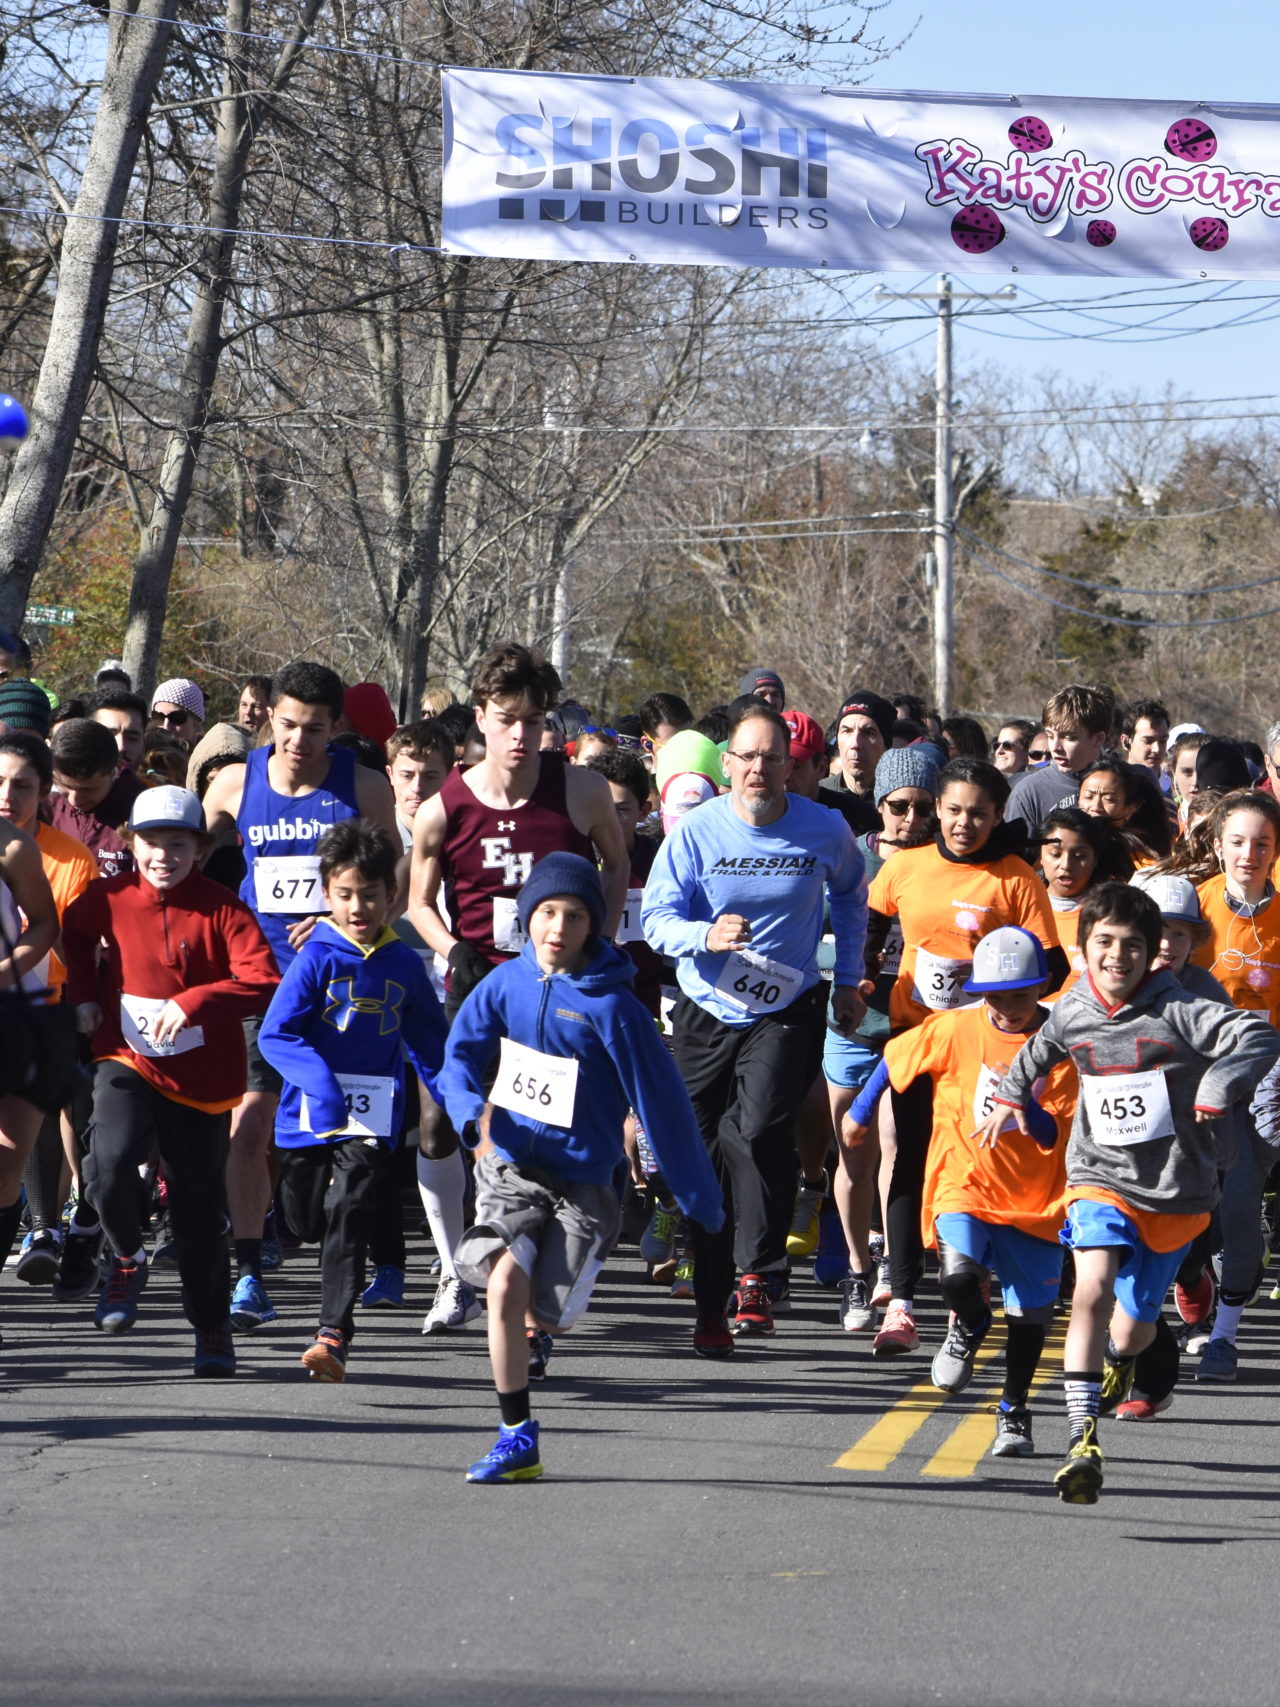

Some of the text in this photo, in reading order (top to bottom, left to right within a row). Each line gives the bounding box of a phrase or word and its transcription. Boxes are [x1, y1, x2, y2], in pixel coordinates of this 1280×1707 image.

[495, 112, 828, 199] SHOSHI
[923, 146, 1109, 217] Katy's
[618, 200, 830, 230] BUILDERS
[709, 868, 815, 877] TRACK & FIELD
[713, 856, 818, 870] MESSIAH
[272, 878, 317, 900] 677
[733, 973, 781, 1005] 640
[929, 992, 960, 1004] Chiara
[512, 1071, 553, 1107] 656
[1100, 1094, 1147, 1121] 453
[1106, 1122, 1148, 1136] Maxwell
